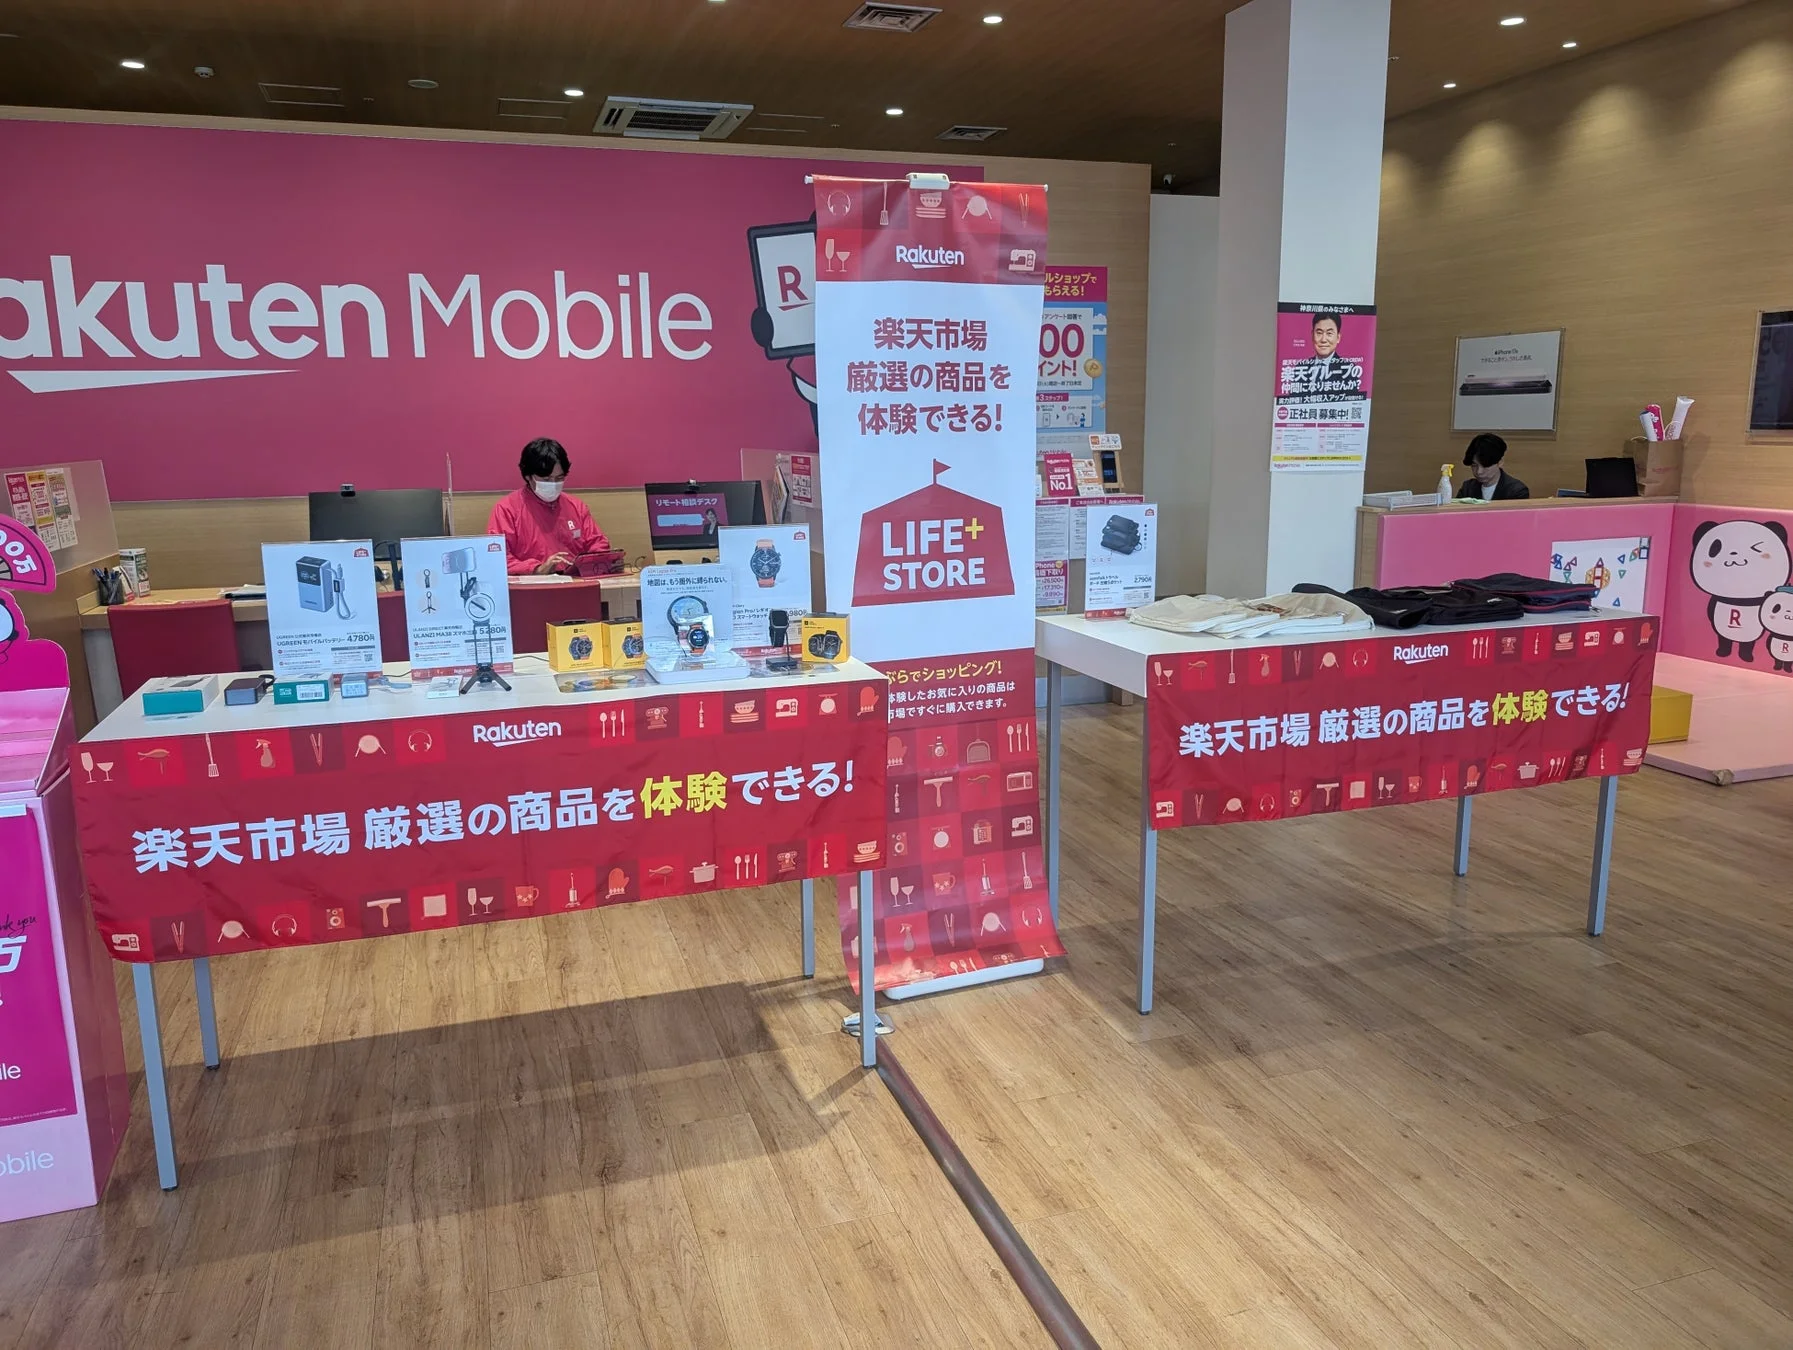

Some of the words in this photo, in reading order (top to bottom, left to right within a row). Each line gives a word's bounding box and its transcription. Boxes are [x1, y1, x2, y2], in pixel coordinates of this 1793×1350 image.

[896, 244, 965, 267] Rakuten
[777, 265, 808, 302] R
[408, 270, 712, 360] Mobile
[873, 317, 987, 351] 楽天市場
[847, 360, 1010, 394] 厳選の商品を
[1281, 363, 1363, 383] 楽天グループの
[1281, 379, 1361, 395] 仲間になりませんか?
[858, 402, 1003, 436] 体験できる!
[1289, 408, 1317, 420] 正社員
[1319, 408, 1349, 420] 募集中!
[882, 517, 984, 557] LIFE+
[883, 558, 985, 591] STORE
[1729, 609, 1742, 626] R
[1393, 643, 1449, 662] Rakuten
[1782, 643, 1789, 652] R
[472, 718, 562, 745] Rakuten
[1179, 712, 1311, 758] 楽天市場
[1317, 681, 1630, 745] 厳選の商品を体験できる!
[132, 811, 350, 874] 楽天市場
[363, 759, 854, 852] 厳選の商品を体験できる!
